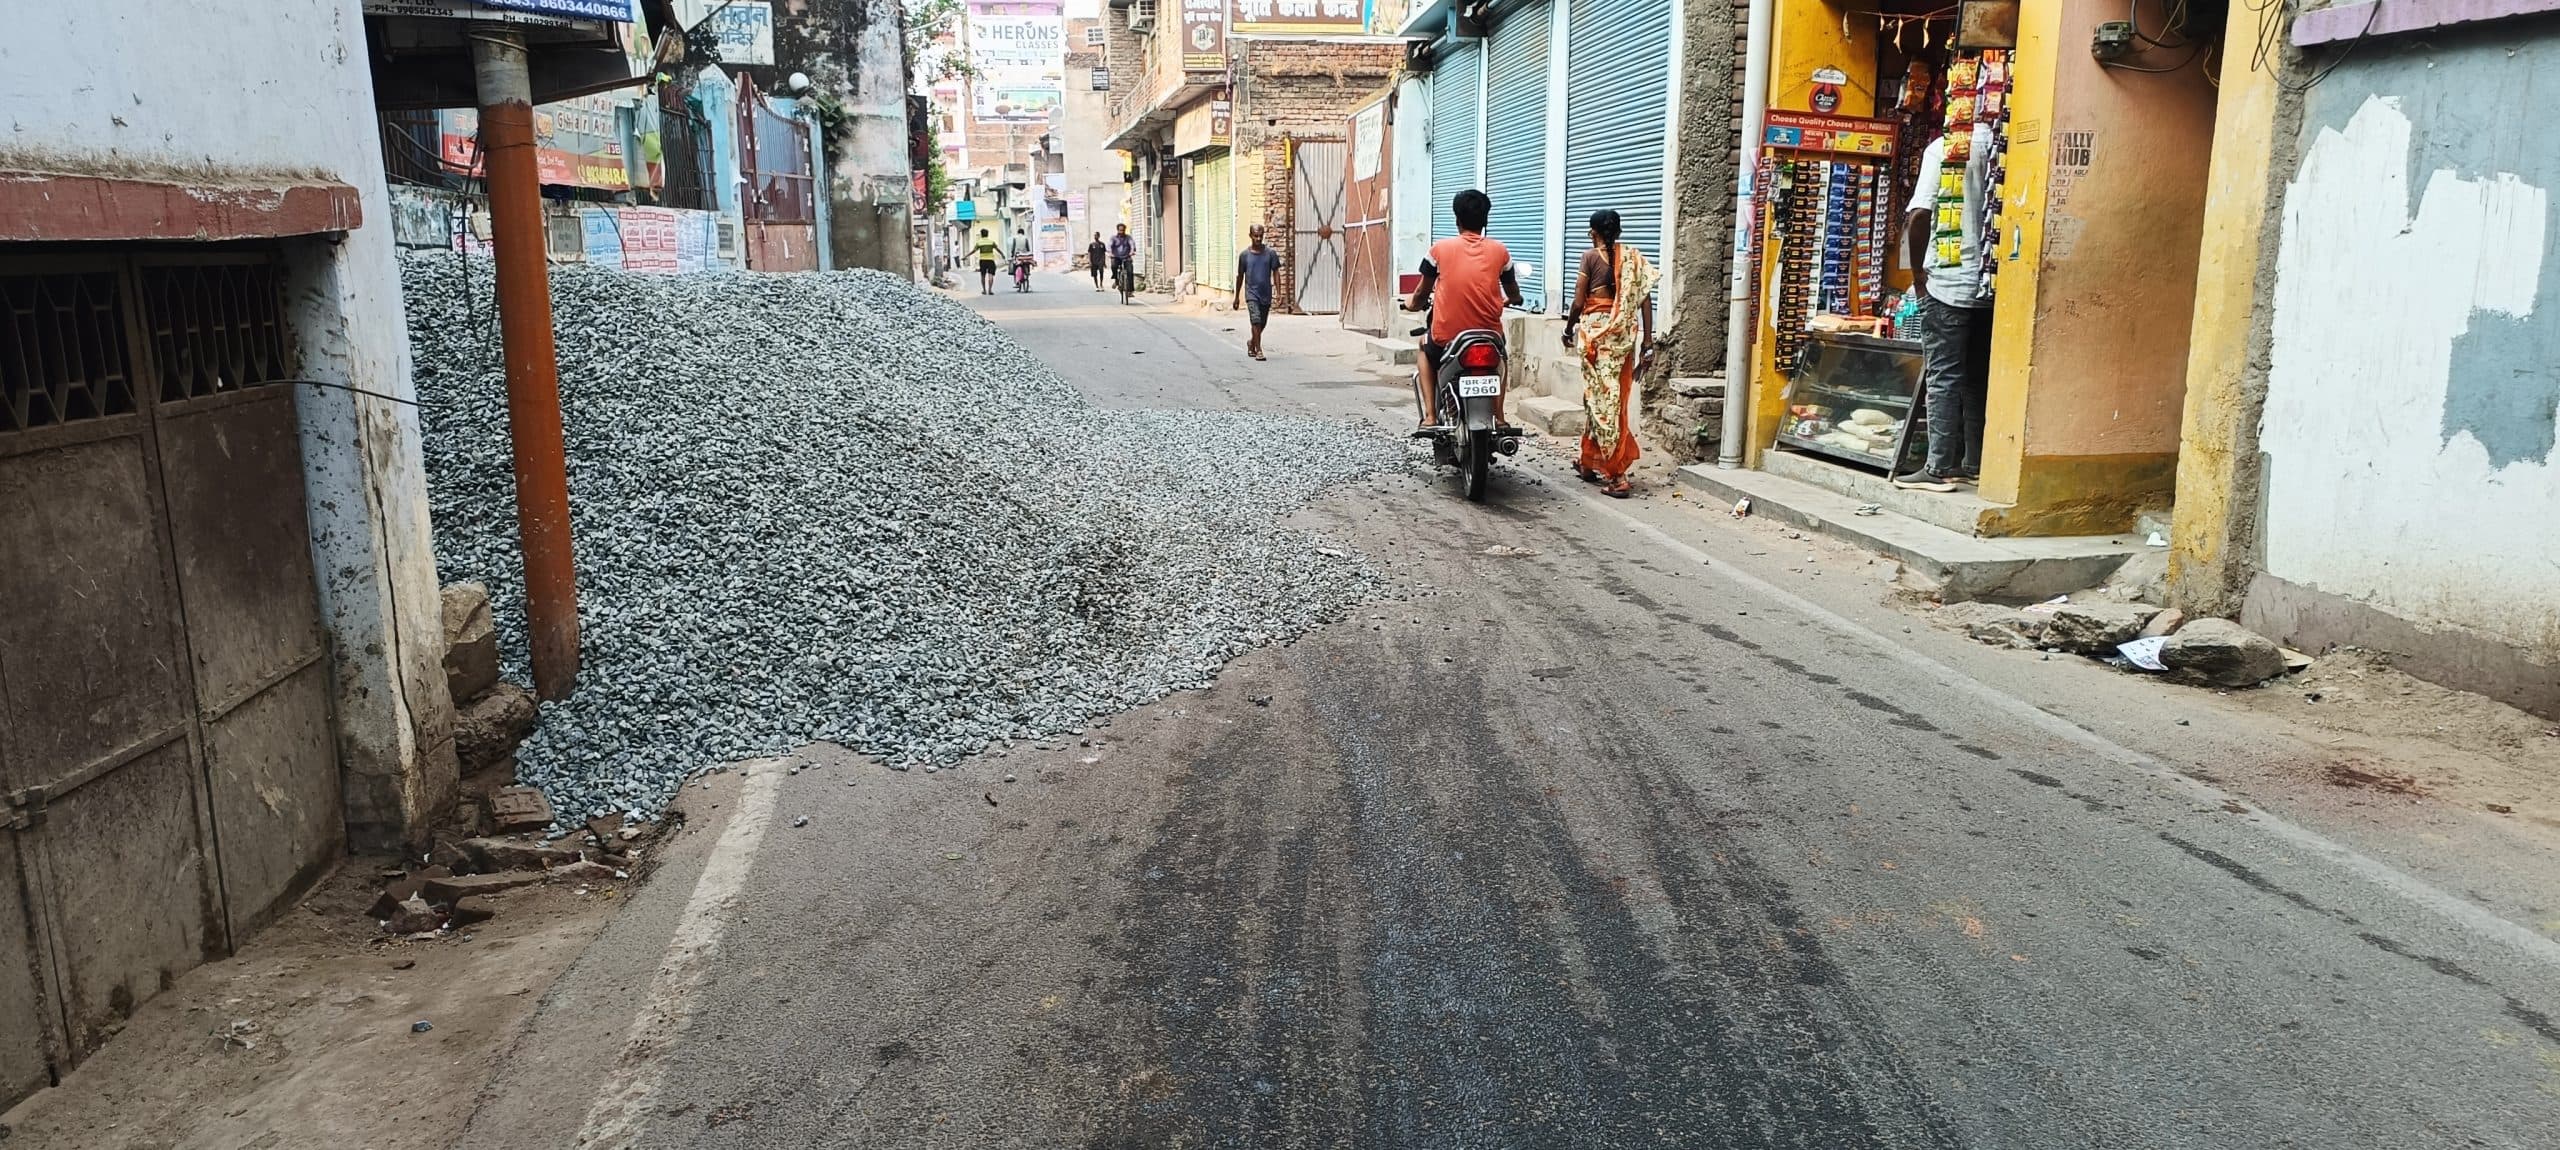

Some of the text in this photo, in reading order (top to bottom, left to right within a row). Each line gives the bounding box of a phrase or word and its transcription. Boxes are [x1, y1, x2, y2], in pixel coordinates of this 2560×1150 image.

[993, 24, 1059, 40] HERONS
[1016, 40, 1059, 49] CLASSES
[1771, 115, 1797, 124] Choose
[1798, 117, 1825, 127] Quality
[1826, 120, 1853, 128] Choose
[2055, 132, 2095, 148] TALLY
[2055, 148, 2091, 166] HUB
[1464, 386, 1497, 395] 7960
